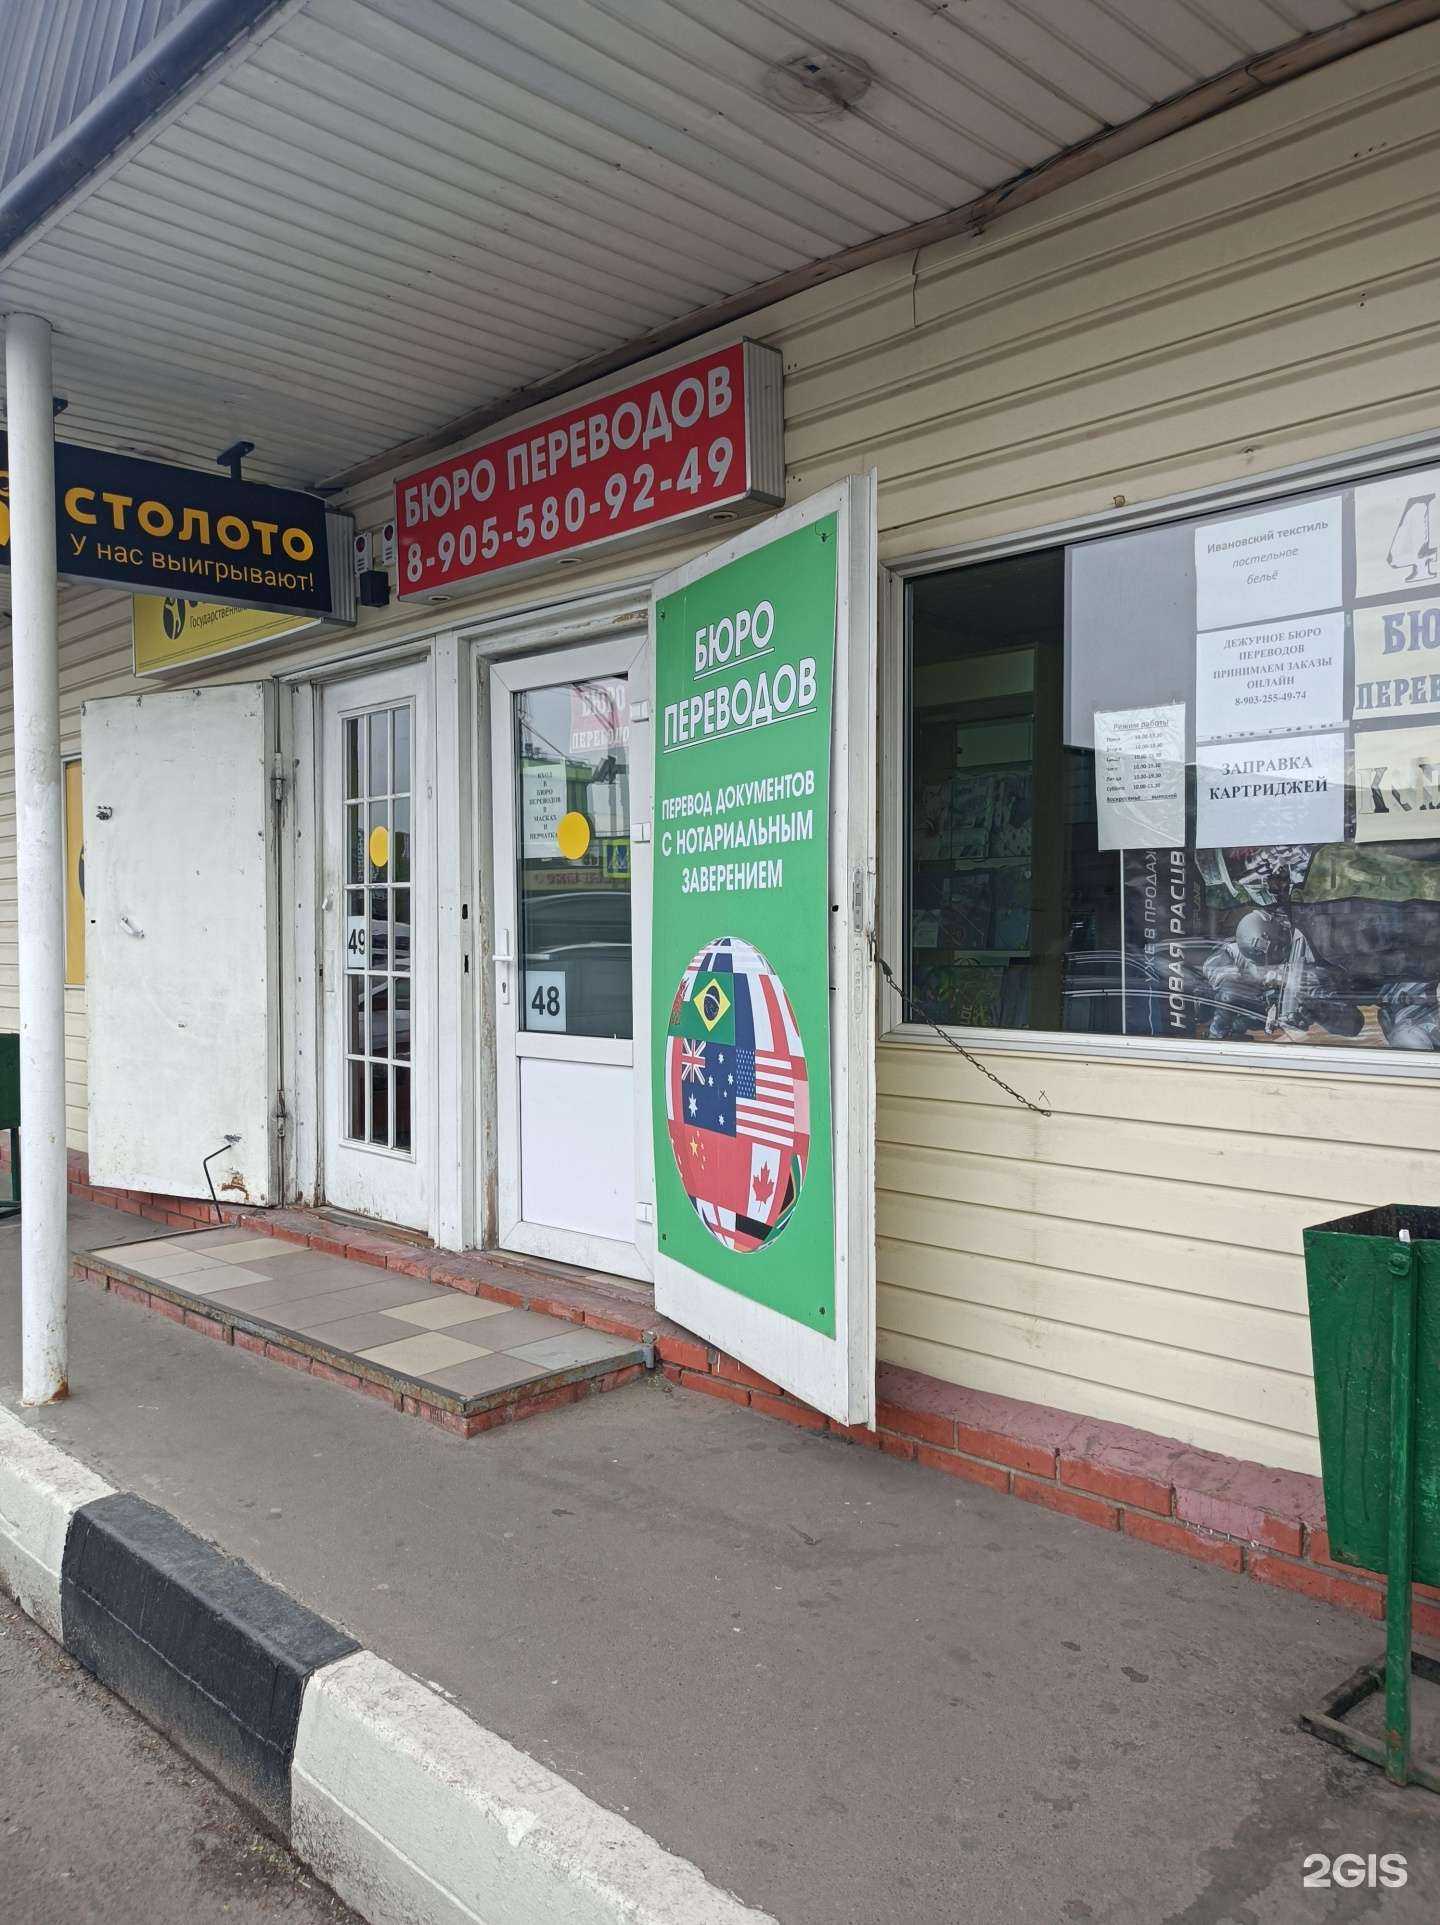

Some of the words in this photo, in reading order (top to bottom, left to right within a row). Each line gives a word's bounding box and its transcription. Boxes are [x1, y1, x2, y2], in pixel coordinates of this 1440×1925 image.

[405, 458, 497, 528] БЮРО
[506, 366, 733, 491] ПЕРЕВОДОВ
[406, 436, 734, 583] 8-905-580-92-49
[1207, 532, 1274, 554] Ивановский
[1278, 521, 1329, 538] текстиль
[97, 542, 144, 566] нас
[152, 551, 314, 593] выигрывают!
[1232, 547, 1299, 569] постельное
[694, 600, 775, 673] БЮРО
[1223, 632, 1285, 650] ДЕЖУРНОЕ
[1288, 627, 1322, 642] БЮРО
[1239, 644, 1306, 661] ПЕРЕВОДОВ
[1213, 662, 1284, 680] ПРИНИМАЕМ
[1287, 657, 1333, 673] ЗАКАЗЫ
[664, 656, 818, 747] ПЕРЕВОДОВ
[1222, 756, 1313, 776] ЗАПРАВКА
[662, 791, 713, 820] ПЕРЕВОД
[716, 770, 815, 814] ДОКУМЕНТОВ
[1209, 775, 1328, 801] КАРТРИДЖЕЙ
[662, 830, 672, 857] С
[676, 809, 813, 855] НОТАРИАЛЬНЫМ
[681, 859, 783, 895] ЗАВЕРЕНИЕМ
[348, 928, 365, 955] 49
[1145, 928, 1156, 939] В
[531, 985, 560, 1016] 48
[1168, 942, 1186, 1029] НОВАЯ
